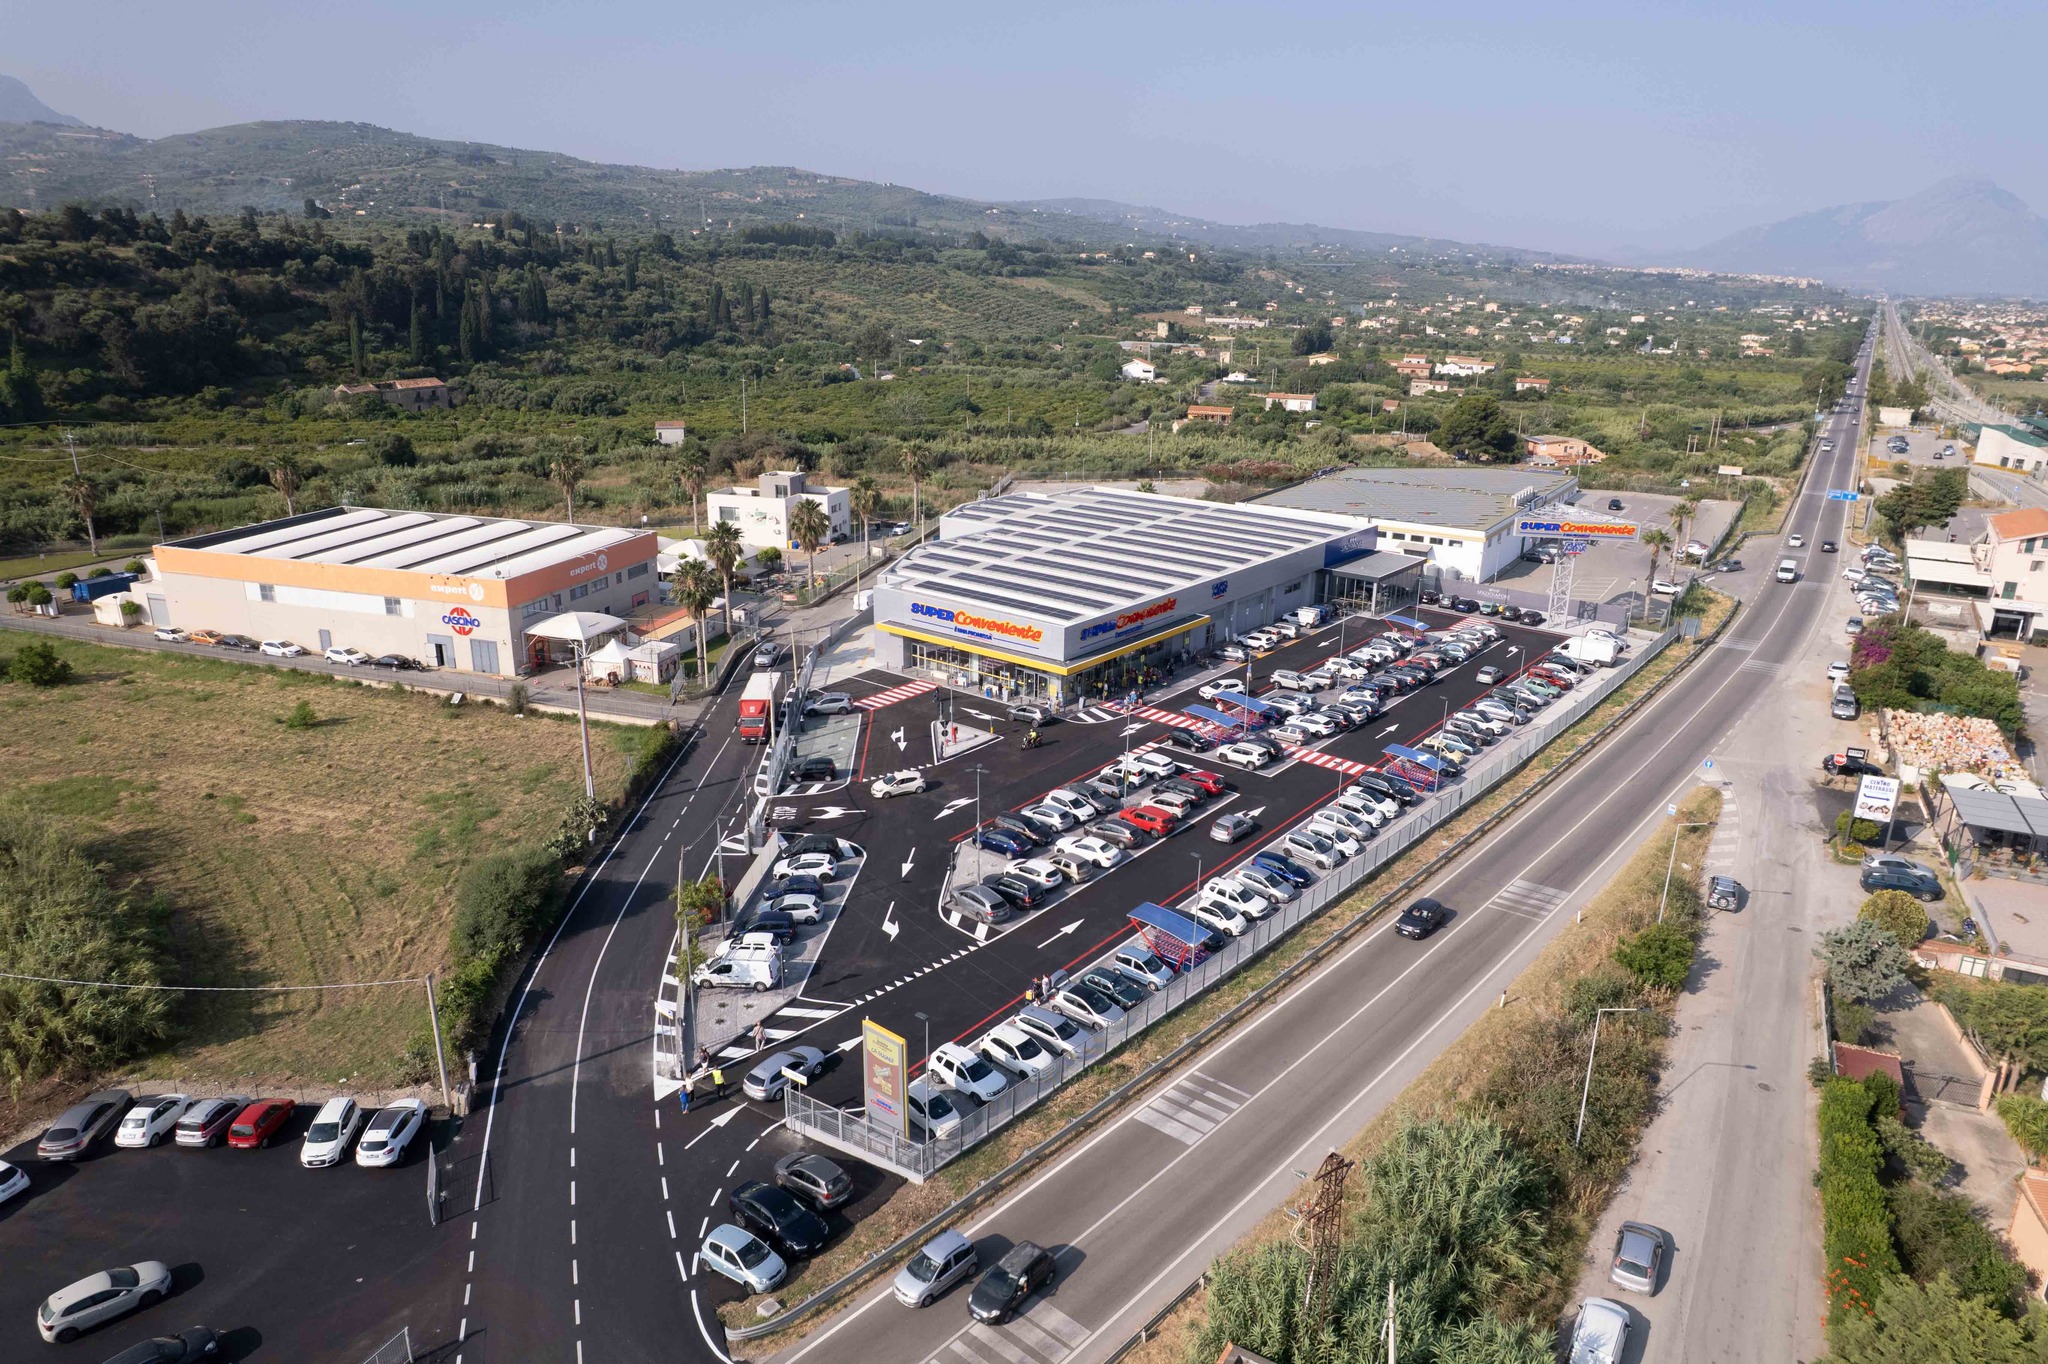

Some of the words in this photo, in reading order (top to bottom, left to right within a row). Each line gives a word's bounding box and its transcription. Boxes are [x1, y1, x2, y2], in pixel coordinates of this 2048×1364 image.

[570, 561, 596, 577] expert
[430, 584, 467, 595] expert
[442, 615, 480, 628] CASCINO
[772, 806, 798, 820] STOP
